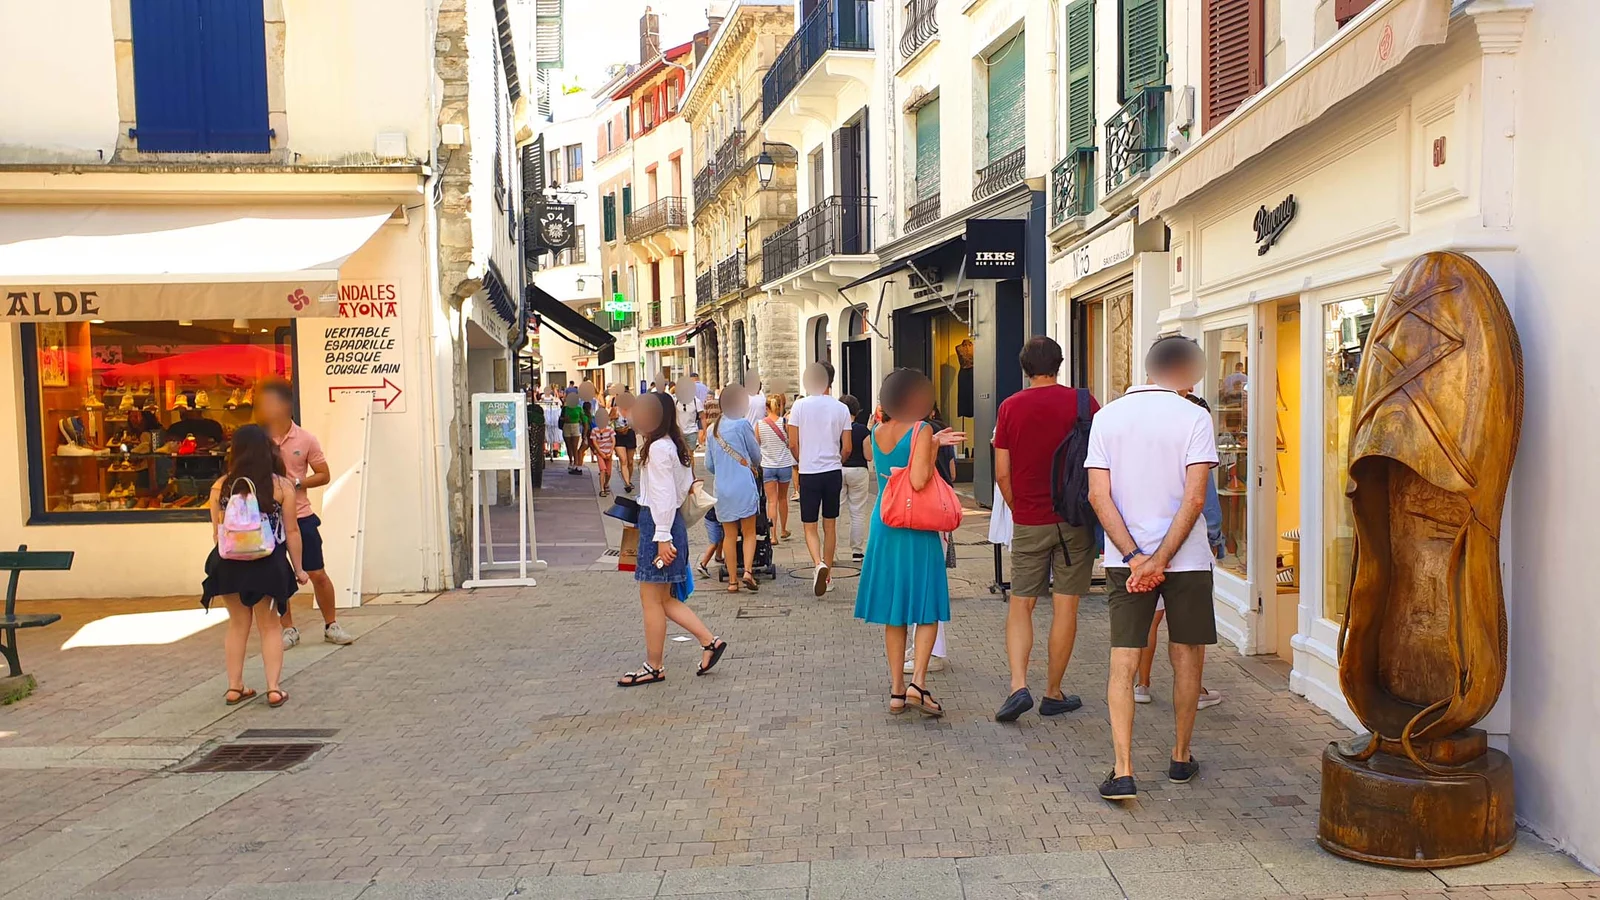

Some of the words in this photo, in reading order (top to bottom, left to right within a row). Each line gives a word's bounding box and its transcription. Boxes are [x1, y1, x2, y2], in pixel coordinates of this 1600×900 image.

[540, 212, 573, 228] ADAM
[976, 252, 1015, 261] IKKS
[4, 291, 100, 316] ALDE
[338, 302, 397, 319] AYONA
[325, 327, 390, 338] VERITABLE
[324, 339, 395, 351] ESPADRILLE
[325, 351, 382, 363] BASQUE
[326, 364, 369, 375] COUSUE
[371, 363, 401, 374] MAIN
